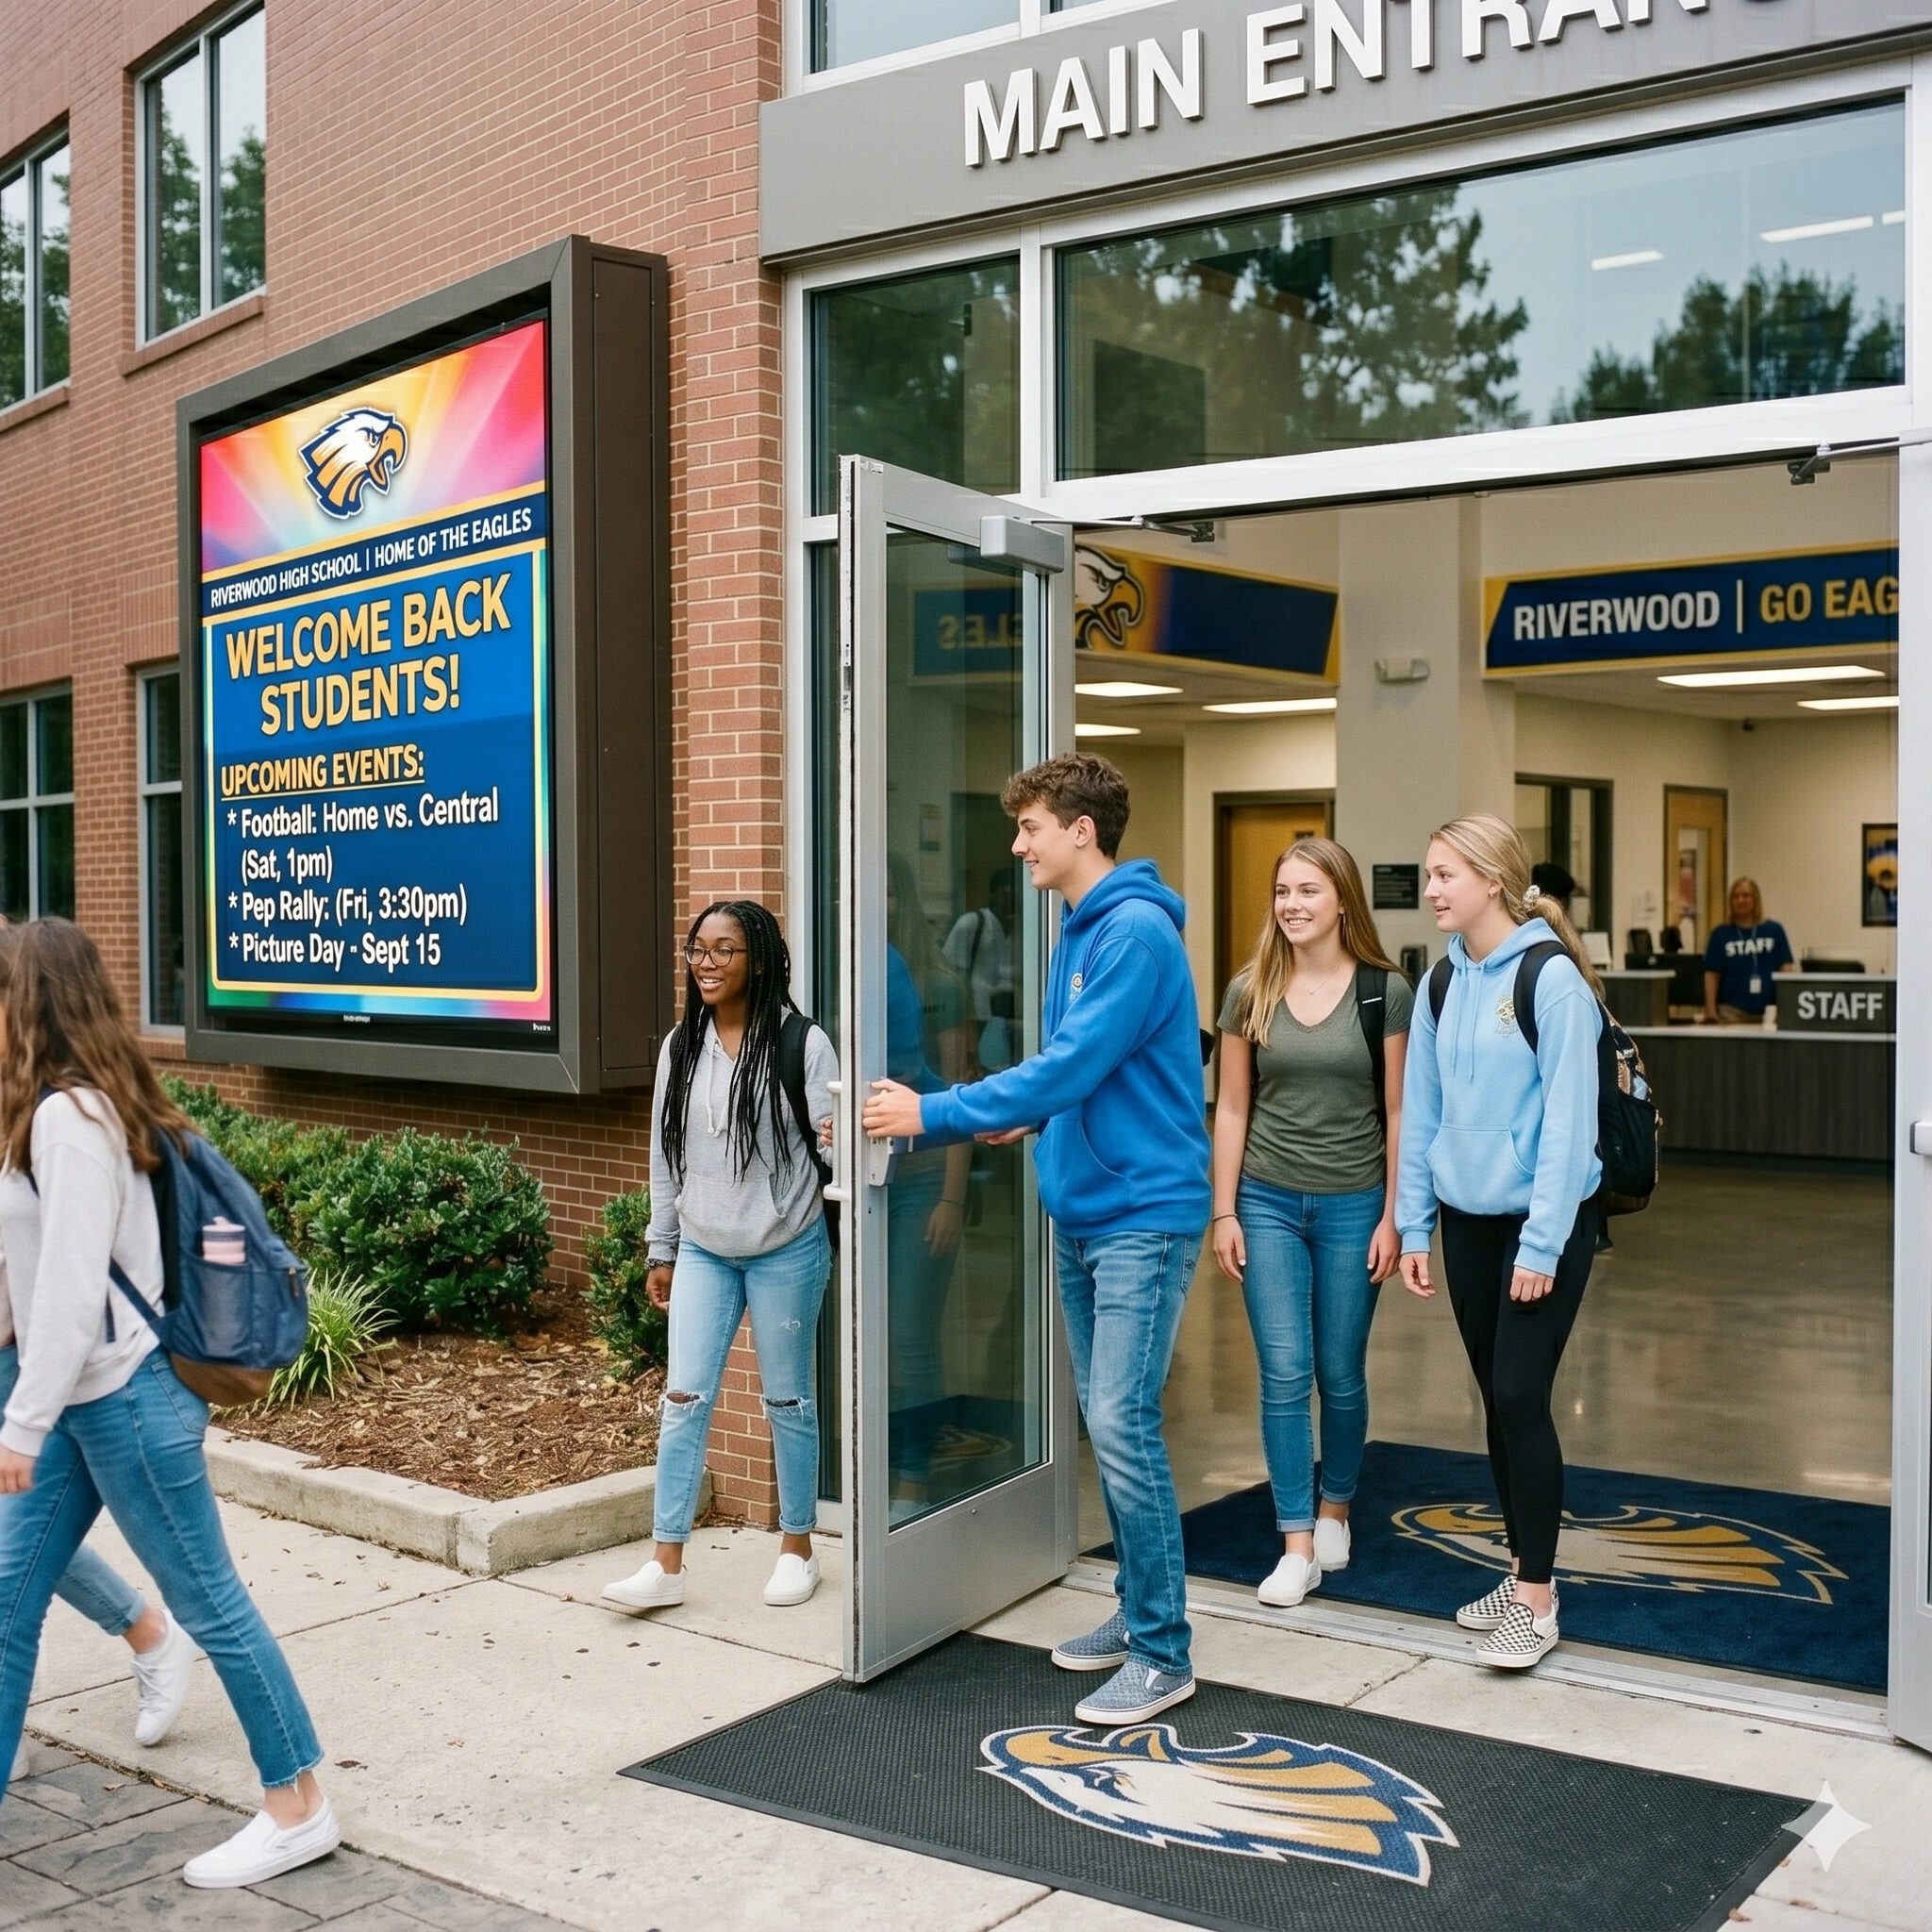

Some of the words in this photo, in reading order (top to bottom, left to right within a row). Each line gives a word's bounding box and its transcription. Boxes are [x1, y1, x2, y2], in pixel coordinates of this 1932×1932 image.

[964, 27, 1204, 168] MAIN
[211, 571, 277, 608] RIVERWOOD
[279, 565, 309, 591] HIGH
[311, 552, 362, 584] SCHOOL
[375, 537, 415, 569] HOME
[418, 532, 437, 558] OF
[440, 523, 469, 551] THE
[472, 508, 532, 544] EAGLES
[226, 599, 391, 679] WELCOME
[403, 573, 512, 648] BACK
[1514, 591, 1721, 641] RIVERWOOD
[1760, 583, 1812, 623] GO
[260, 655, 460, 735] STUDENTS!
[221, 753, 327, 797] UPCOMING
[332, 743, 425, 787] EVENTS:
[242, 804, 317, 839] Football:
[323, 800, 379, 833] Home
[384, 803, 413, 829] vs.
[419, 786, 499, 826] Central
[242, 848, 281, 886] (Sat,
[287, 844, 333, 884] 1pm)
[242, 891, 275, 928] Pep
[279, 889, 329, 927] Rally:
[335, 887, 373, 926] (Fri,
[378, 883, 467, 926] 3:30pm)
[242, 932, 305, 963] Picture
[309, 933, 345, 973] Day
[361, 932, 409, 974] Sept
[415, 932, 441, 966] 15
[1724, 937, 1774, 958] STAFF
[1797, 991, 1883, 1020] STAFF
